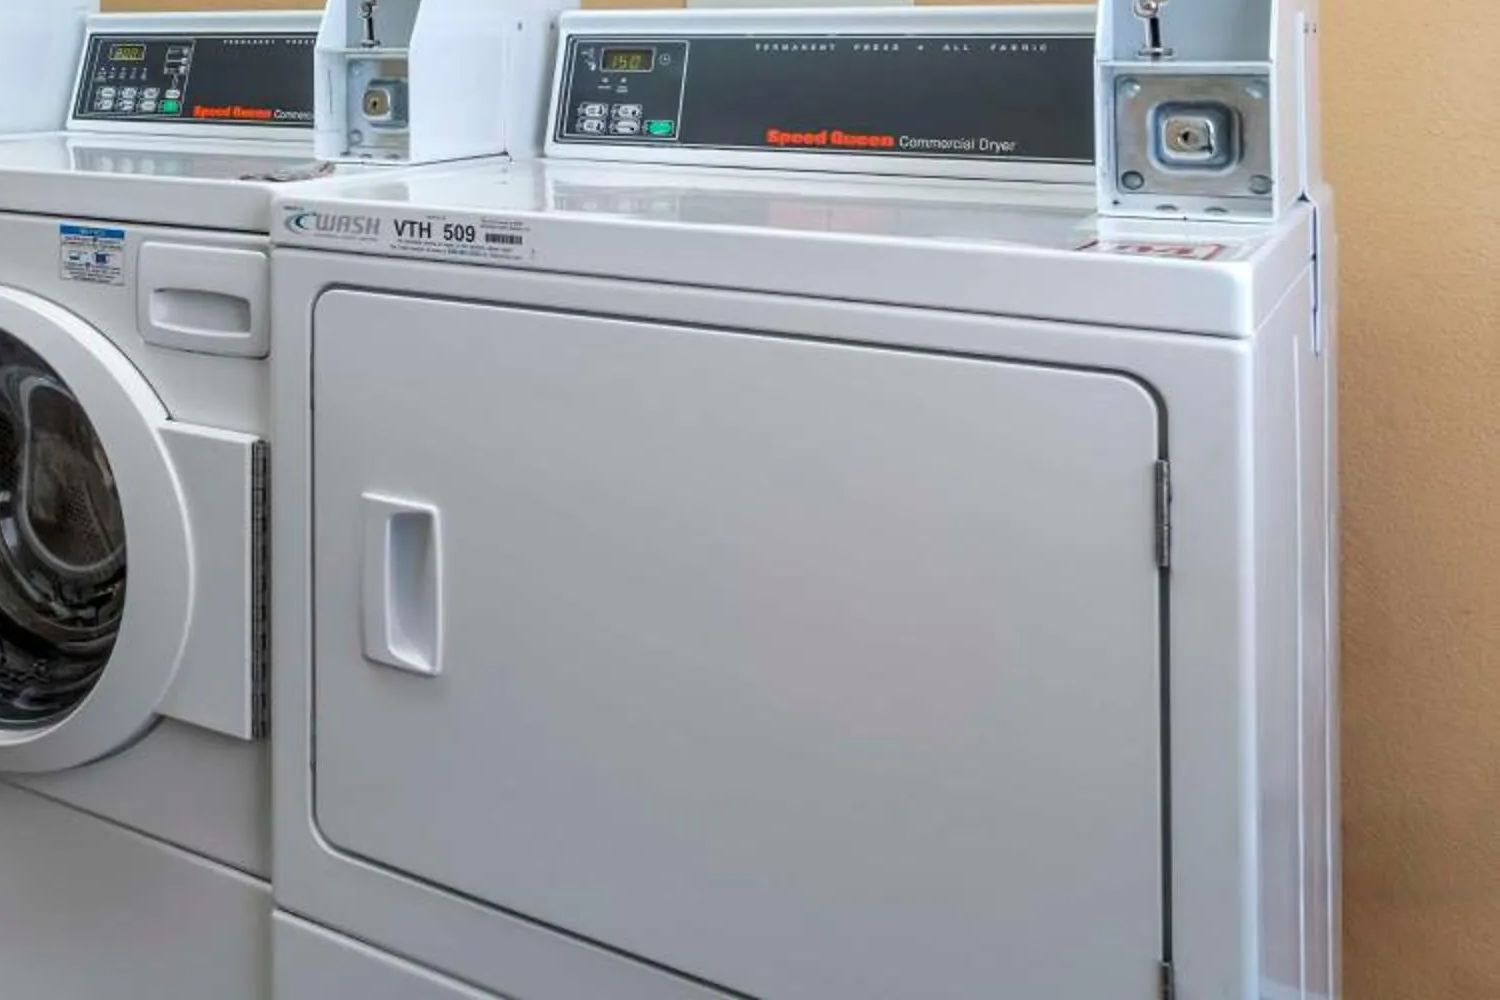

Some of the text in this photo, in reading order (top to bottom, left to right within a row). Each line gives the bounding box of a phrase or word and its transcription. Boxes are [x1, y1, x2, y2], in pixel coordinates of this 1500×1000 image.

[754, 42, 836, 52] PERMANENT
[942, 43, 972, 52] ALL
[194, 105, 231, 119] Speed
[233, 106, 272, 119] Queen
[766, 128, 1016, 153] Speed Queen Commercial Dryer
[316, 212, 381, 236] WASH
[394, 219, 432, 239] VTH
[443, 223, 476, 243] 509
